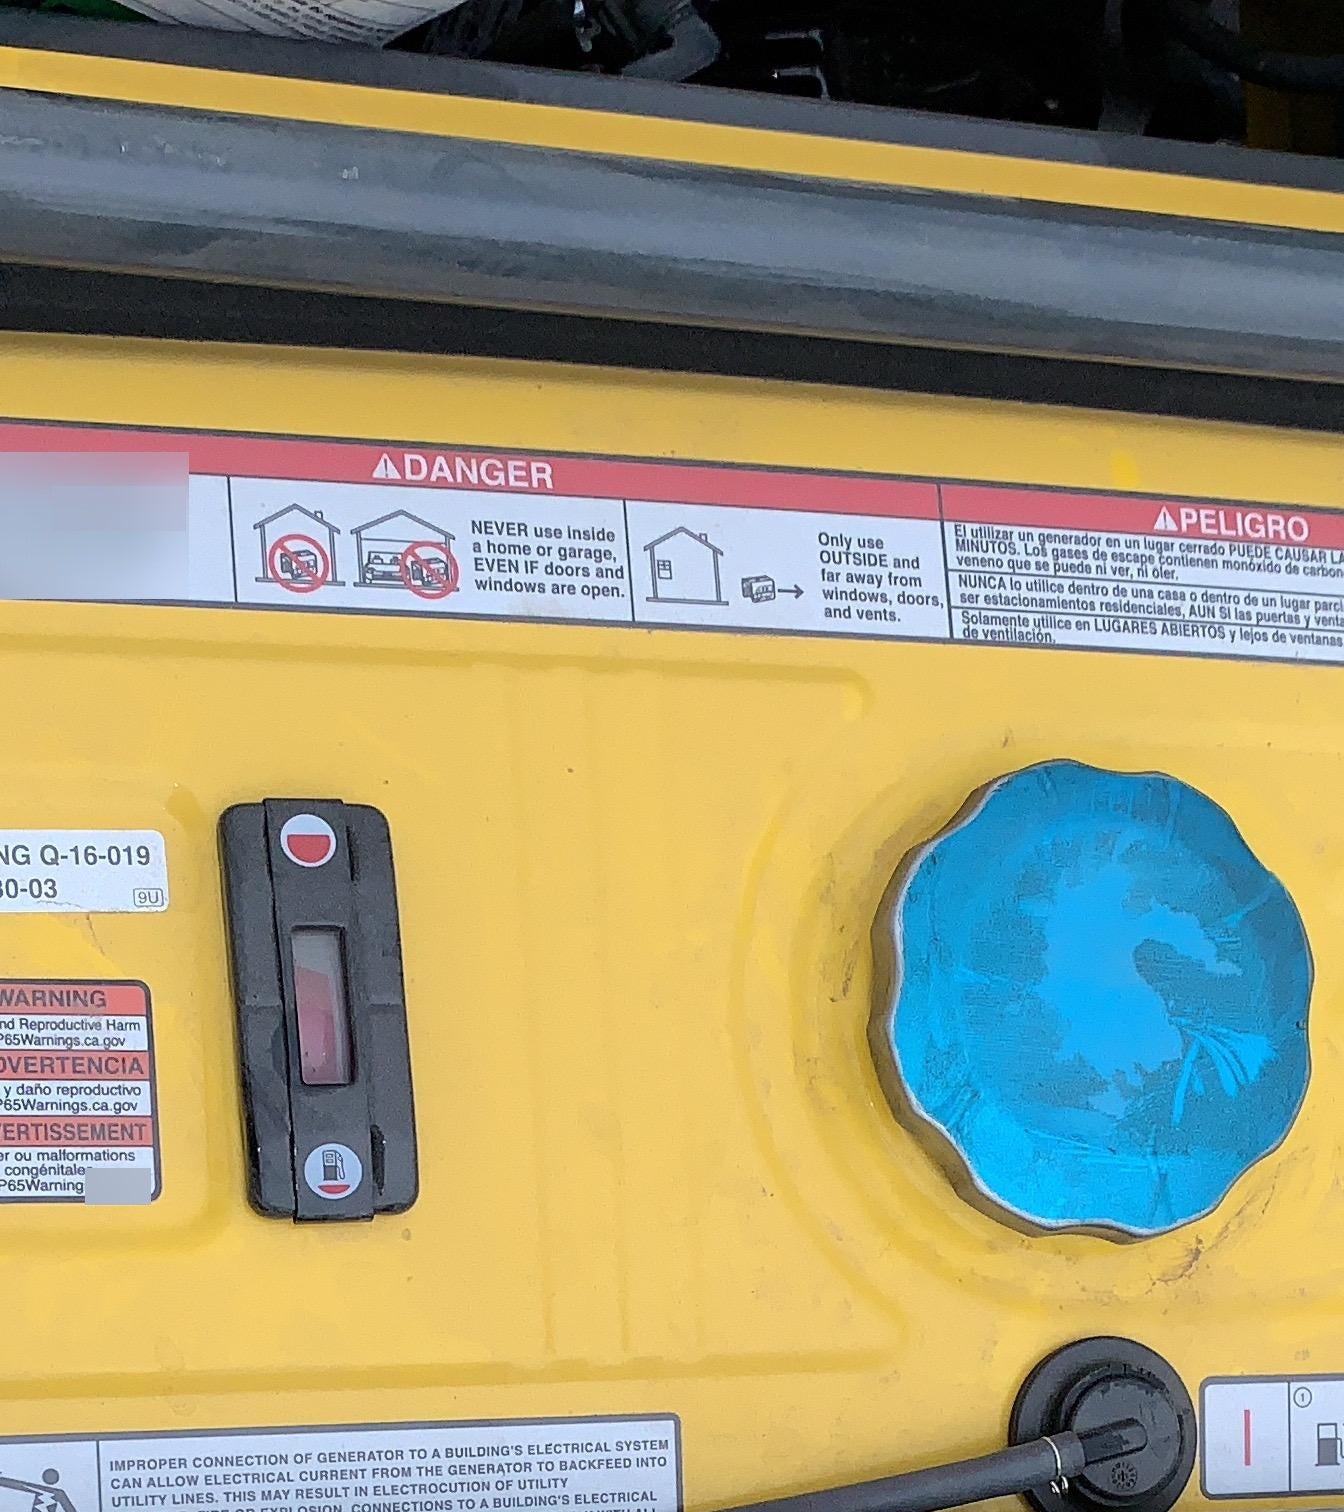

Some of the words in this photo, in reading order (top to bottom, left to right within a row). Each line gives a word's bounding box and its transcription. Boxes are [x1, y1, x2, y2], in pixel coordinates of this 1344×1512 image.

[404, 453, 554, 489] DANGER
[471, 521, 528, 536] NEVER
[533, 527, 562, 538] use
[567, 526, 615, 541] inside
[1180, 508, 1309, 541] PELIGRO
[817, 532, 851, 550] Only
[857, 538, 883, 549] use
[472, 544, 481, 554] a
[486, 542, 530, 556] home
[536, 548, 552, 558] or
[557, 549, 616, 564] garage,
[819, 551, 888, 568] OUTSIDE
[893, 556, 920, 570] and
[955, 557, 1003, 568] veneno
[474, 559, 518, 573] EVEN
[524, 561, 538, 574] IF
[544, 562, 590, 577] doors
[595, 564, 625, 578] and
[820, 569, 840, 583] far
[845, 574, 882, 589] away
[887, 573, 922, 588] from
[474, 578, 545, 594] windows
[551, 585, 575, 596] are
[580, 586, 624, 601] open.
[821, 587, 892, 606] windows,
[896, 592, 944, 610] doors,
[824, 606, 851, 620] and
[856, 608, 900, 622] vents.
[40, 844, 150, 866] Q-16-019
[19, 1018, 102, 1033] Reproductive
[106, 1019, 140, 1031] Harm
[3, 1086, 12, 1098] y
[16, 1082, 52, 1096] daño
[56, 1083, 142, 1099] reproductivo
[14, 1152, 32, 1162] ou
[36, 1149, 136, 1162] malformations
[4, 1163, 90, 1179] congénitale
[110, 1458, 186, 1471] IMPROPER
[192, 1454, 288, 1468] CONNECTION
[293, 1453, 312, 1464] OF
[317, 1450, 403, 1463] GENERATOR
[408, 1449, 426, 1460] TO
[431, 1448, 440, 1459] A
[445, 1445, 522, 1459] BUILDING'S
[527, 1442, 611, 1456] ELECTRICAL
[615, 1440, 668, 1452] SYSTEM
[110, 1478, 141, 1489] CAN
[146, 1475, 199, 1488] ALLOW
[204, 1472, 294, 1486] ELECTRICAL
[299, 1469, 366, 1482] CURRENT
[372, 1467, 411, 1479] FROM
[416, 1466, 442, 1477] THE
[447, 1462, 531, 1476] GENERATOR
[536, 1461, 554, 1472] TO
[559, 1458, 631, 1472] BACKFEED
[636, 1457, 666, 1468] INTO
[112, 1495, 166, 1507] UTILITY
[172, 1492, 218, 1505] LINES.
[223, 1491, 255, 1503] THIS
[261, 1490, 289, 1501] MAY
[295, 1487, 350, 1500] RESULT
[354, 1486, 367, 1497] IN
[373, 1481, 490, 1496] ELECTROCUTION
[495, 1480, 513, 1492] OF
[517, 1478, 567, 1491] UTILITY
[457, 1499, 475, 1510] TO
[479, 1498, 488, 1509] A
[493, 1495, 569, 1508] BUILDING'S
[574, 1491, 656, 1505] ELECTRICAL
